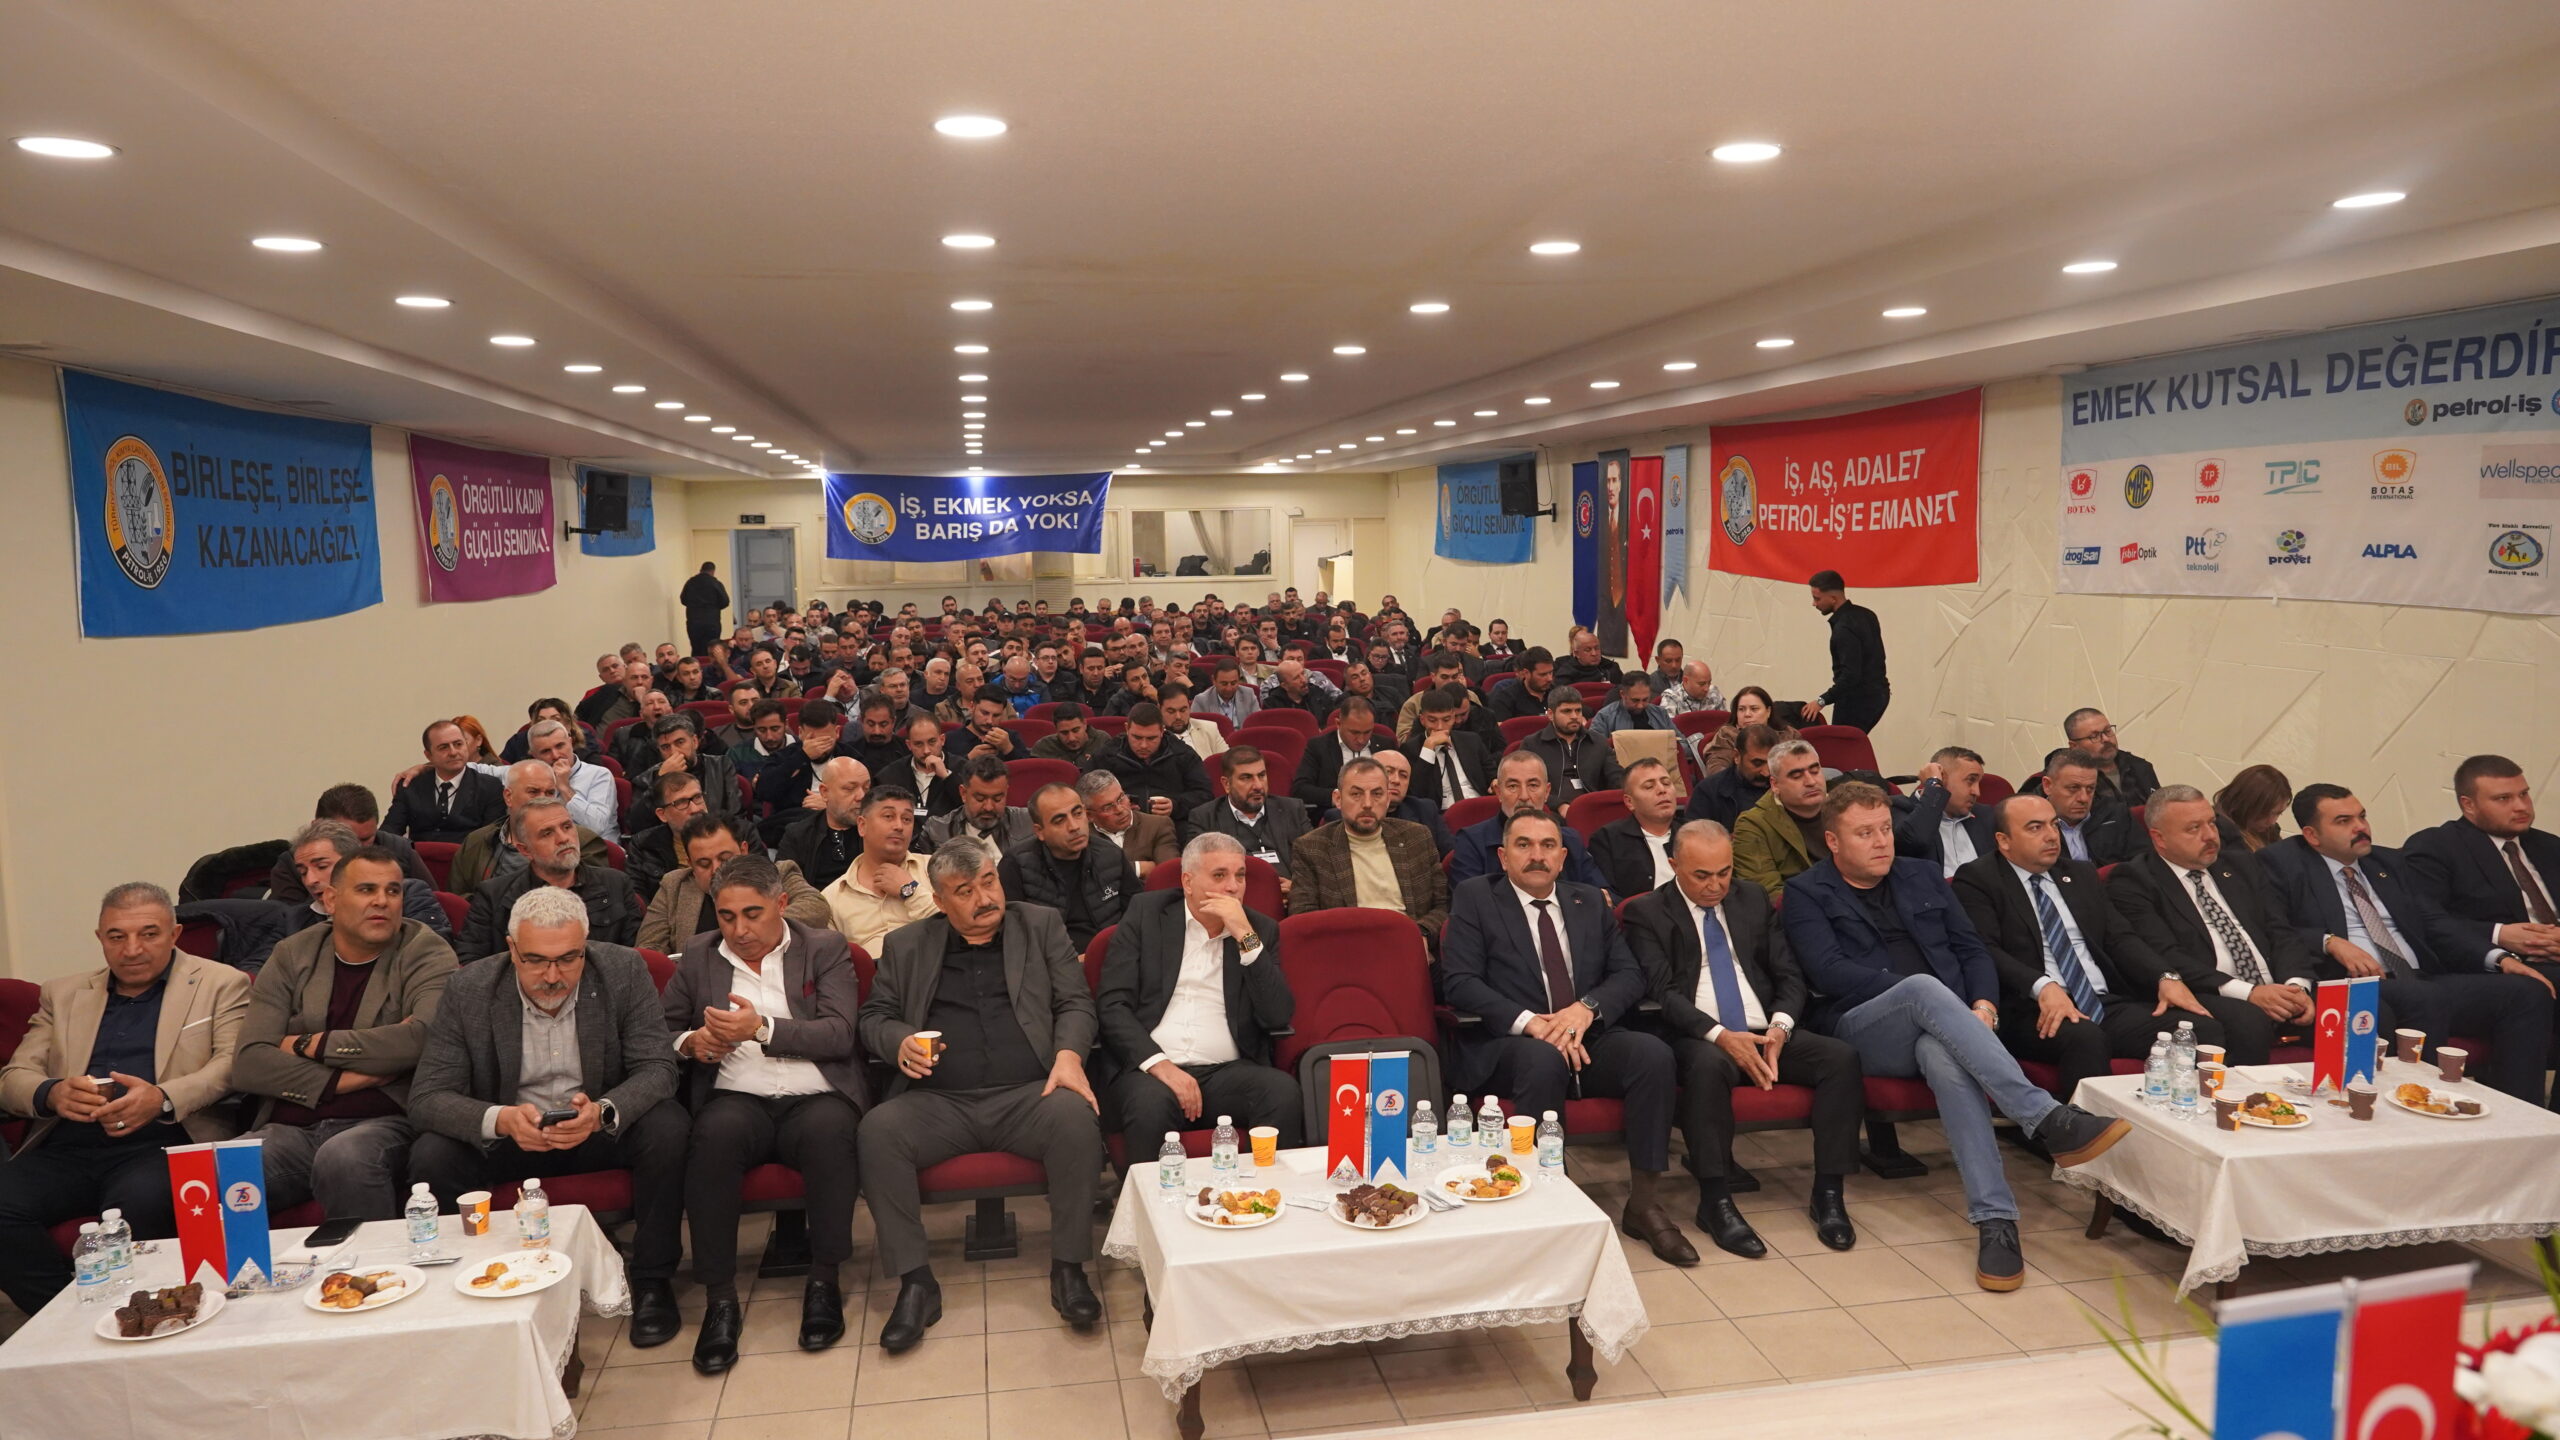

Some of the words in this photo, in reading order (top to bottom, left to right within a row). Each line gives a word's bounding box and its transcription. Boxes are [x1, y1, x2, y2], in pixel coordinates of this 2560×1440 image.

[2072, 379, 2157, 426] EMEK
[2166, 358, 2311, 413] KUTSAL
[171, 443, 283, 514] BİRLEŞE,
[287, 457, 369, 514] BİRLEŞE
[1784, 457, 1804, 496] İŞ,
[1809, 460, 1838, 496] AŞ,
[1843, 448, 1926, 488] ADALET
[462, 475, 514, 514] ÖRGÜTLÜ
[515, 487, 545, 514] KADIN
[900, 493, 927, 519] İŞ,
[933, 497, 1013, 515] EKMEK
[1018, 490, 1093, 510] YOKSA
[2195, 495, 2220, 504] TPAO
[1452, 510, 1482, 539] GÜÇLÜ
[1868, 490, 1959, 531] EMANET
[915, 522, 983, 542] BARIŞ
[989, 517, 1019, 536] DA
[1025, 513, 1079, 531] YOK!
[198, 518, 361, 568] KAZANACAĞIZ!
[463, 521, 503, 567] GÜÇLÜ
[503, 522, 550, 556] SENDİKA!
[2138, 547, 2157, 560] Optik
[2186, 536, 2206, 555] Ptt
[2362, 544, 2417, 559] ALPLA
[153, 556, 169, 579] 1950
[2186, 563, 2219, 572] teknoloji
